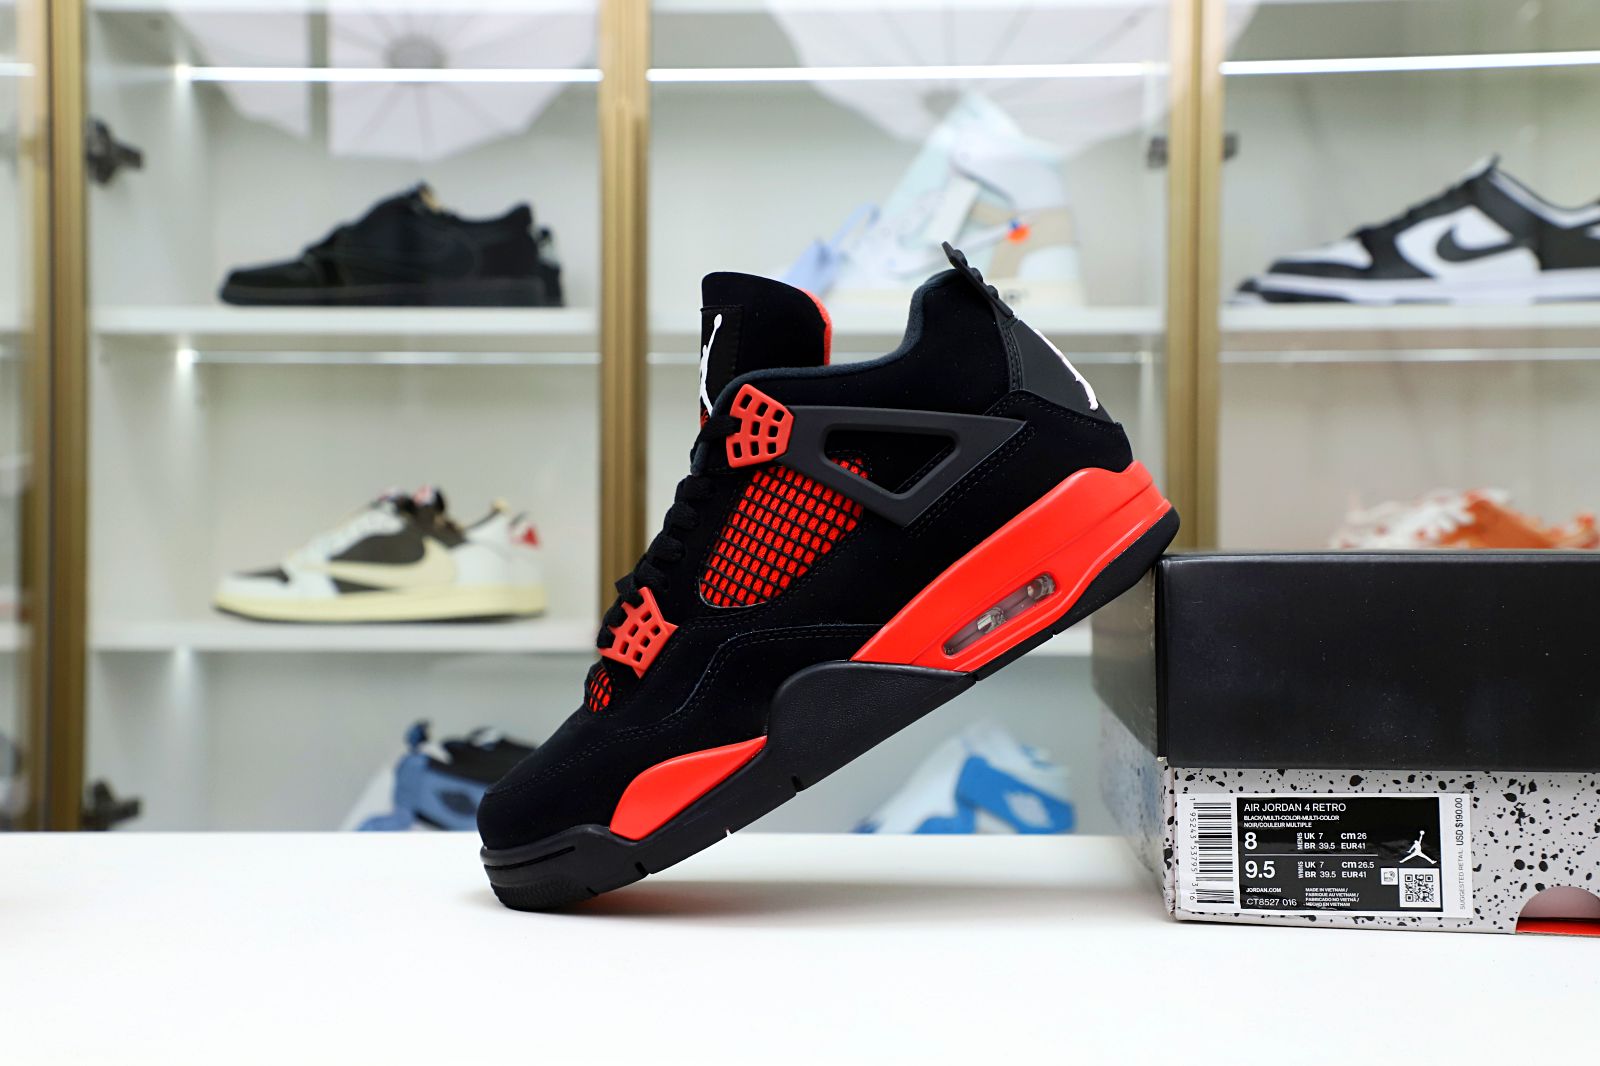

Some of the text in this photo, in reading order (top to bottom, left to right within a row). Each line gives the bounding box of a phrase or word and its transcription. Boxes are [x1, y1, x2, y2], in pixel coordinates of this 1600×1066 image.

[1244, 803, 1347, 812] AIR JORDAN 4 RETRO
[1455, 797, 1465, 828] $190.00
[1189, 812, 1197, 839] 95243
[1244, 831, 1258, 850] 8
[1304, 842, 1336, 850] BR 39.5
[1456, 829, 1464, 846] USD
[1190, 845, 1198, 872] 53795
[1245, 860, 1276, 879] 9.5
[1319, 871, 1336, 879] 39.5
[1246, 898, 1298, 906] CT8527 016
